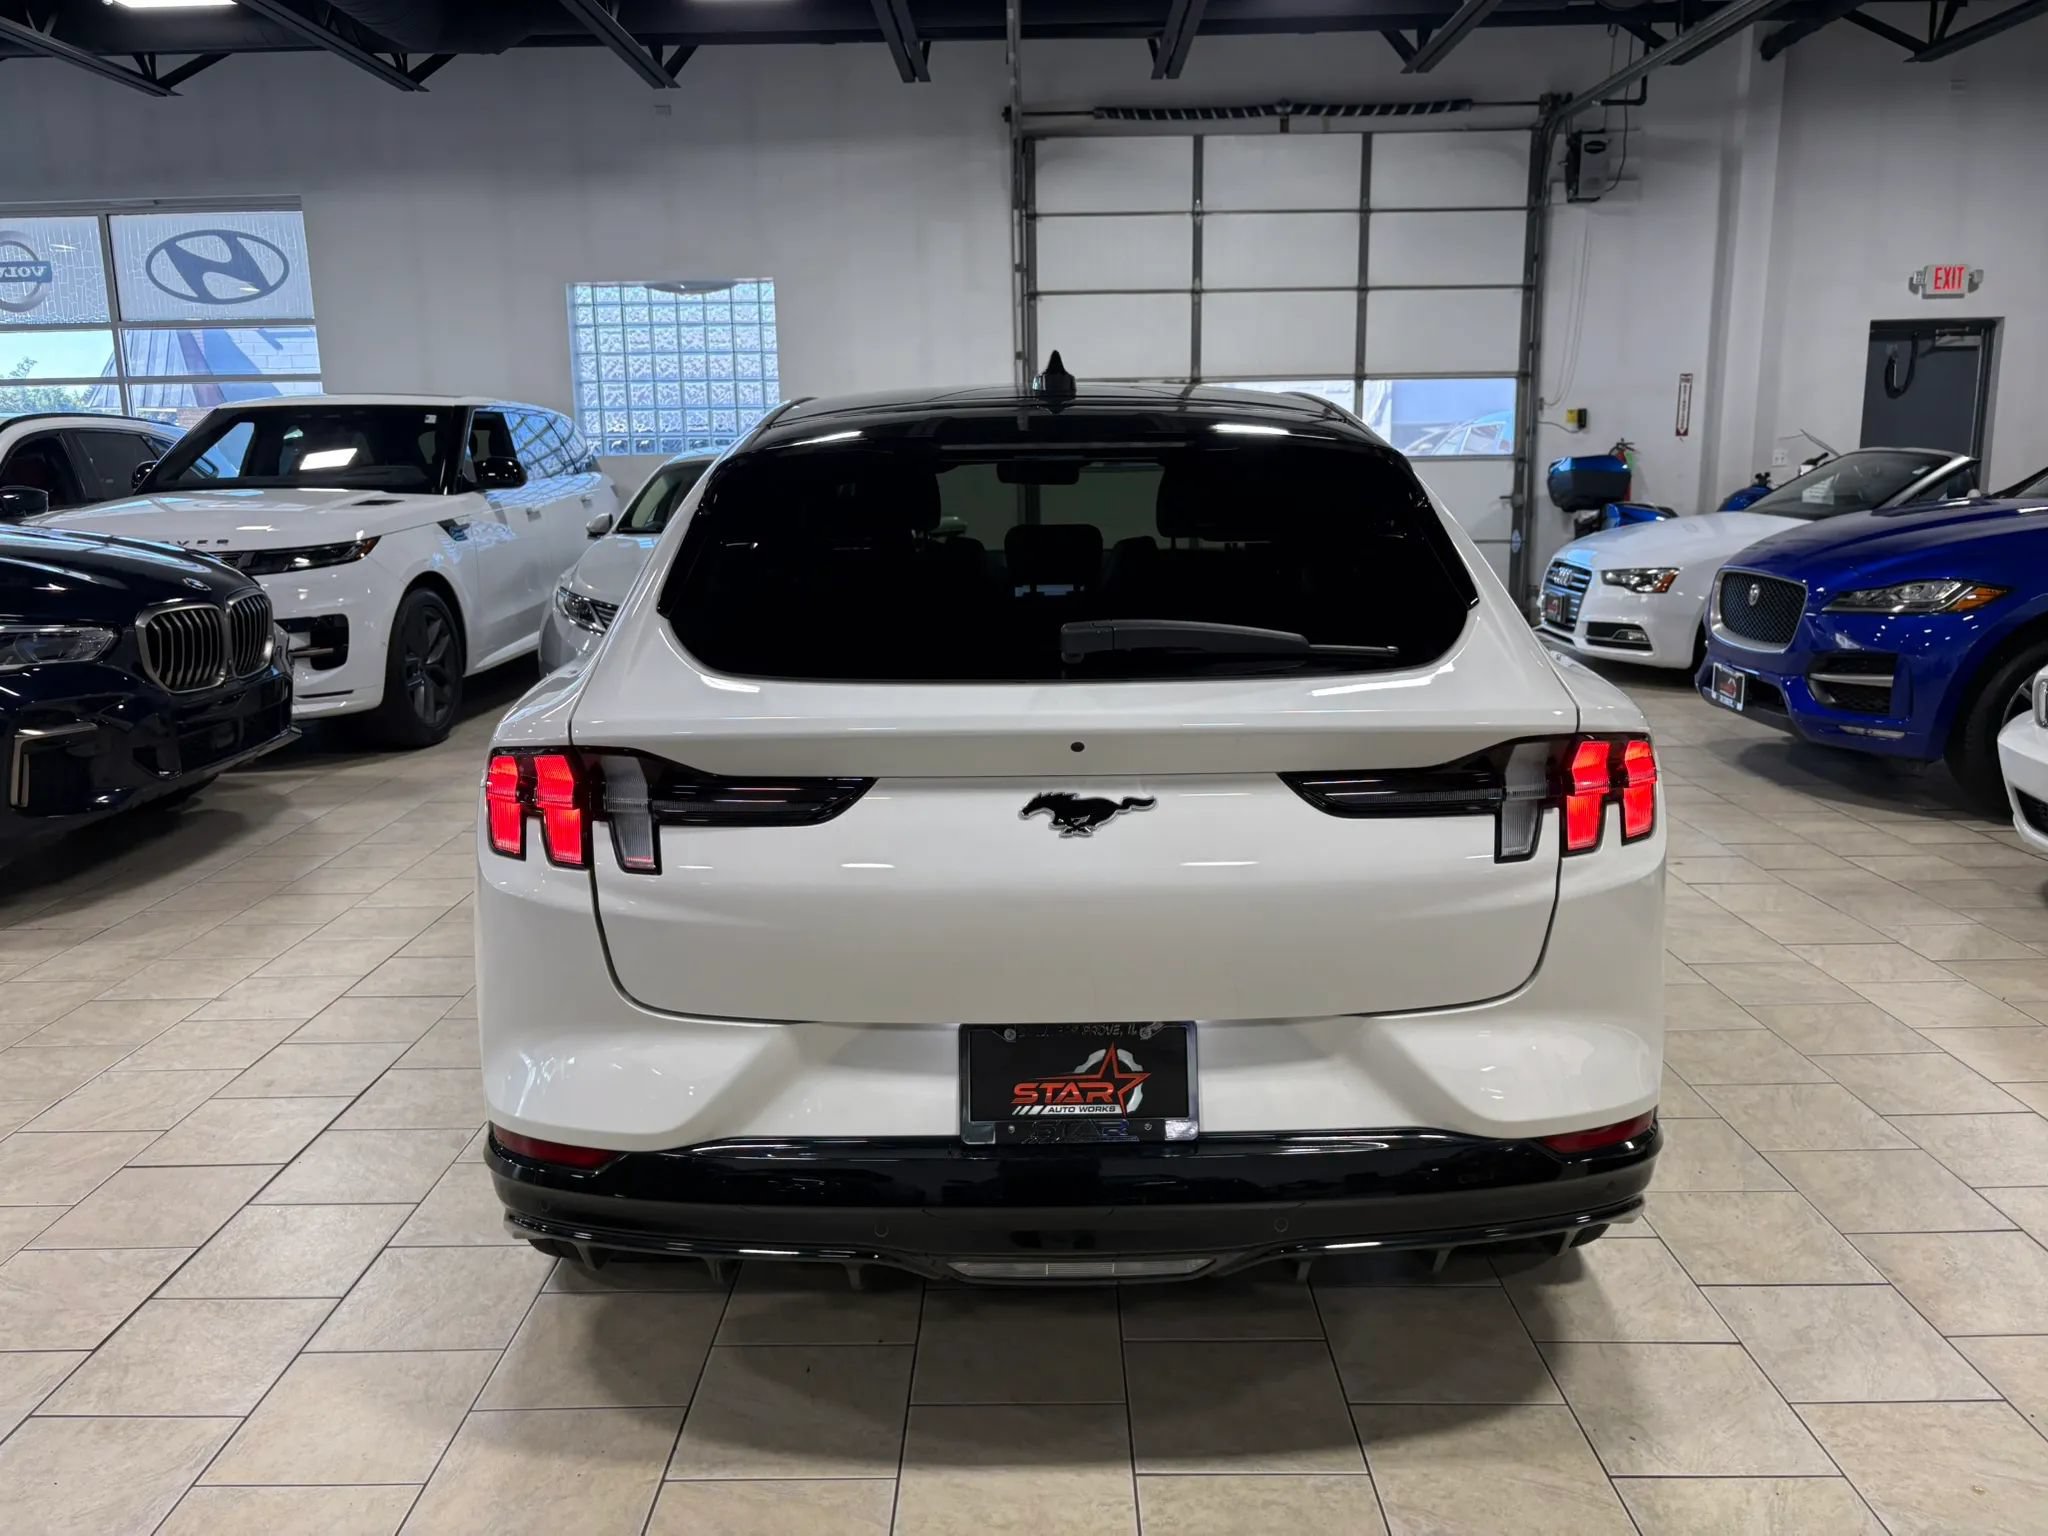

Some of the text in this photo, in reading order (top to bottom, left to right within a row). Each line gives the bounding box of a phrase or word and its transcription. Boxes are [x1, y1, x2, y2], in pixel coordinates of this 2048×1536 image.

[1933, 266, 1965, 290] EXIT
[1011, 1081, 1115, 1104] STAR
[1047, 1105, 1116, 1113] AUTO WORKS
